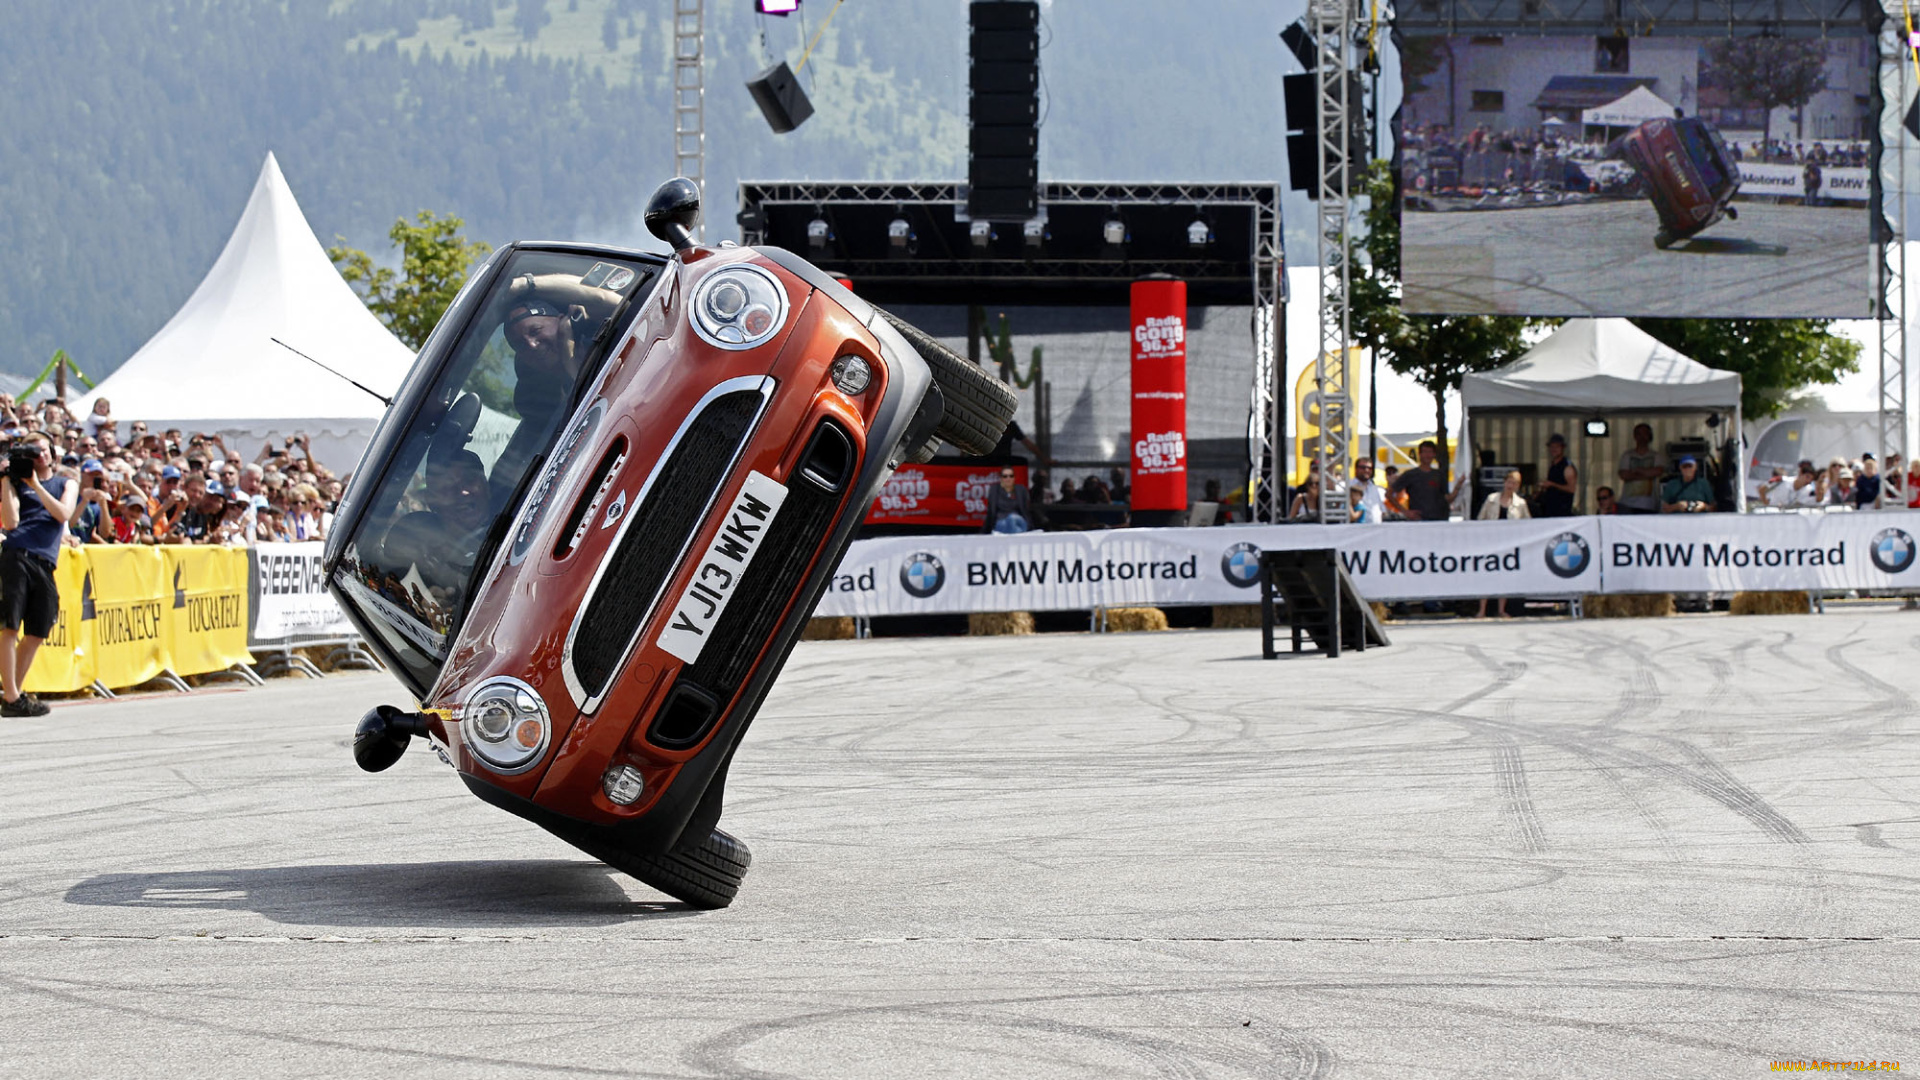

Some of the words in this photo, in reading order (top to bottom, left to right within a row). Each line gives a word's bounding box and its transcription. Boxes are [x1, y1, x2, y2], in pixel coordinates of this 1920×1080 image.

[1742, 173, 1796, 186] Motorrad
[1830, 177, 1865, 189] BMW
[1145, 315, 1182, 328] Radio
[1135, 324, 1184, 343] Gong
[1141, 338, 1176, 353] 96,3
[1146, 431, 1183, 443] Radio
[1135, 440, 1185, 459] Gong
[1142, 453, 1177, 468] 96,3
[888, 469, 924, 480] adio
[880, 496, 918, 511] 96,3
[1379, 547, 1521, 575] Motorrad
[1612, 543, 1694, 568] BMW
[1703, 541, 1845, 567] Motorrad
[671, 562, 733, 637] YJ13
[714, 491, 772, 563] WKW
[967, 560, 1048, 586] BMW
[1057, 555, 1197, 584] Motorrad
[97, 602, 161, 646] TOURATECH
